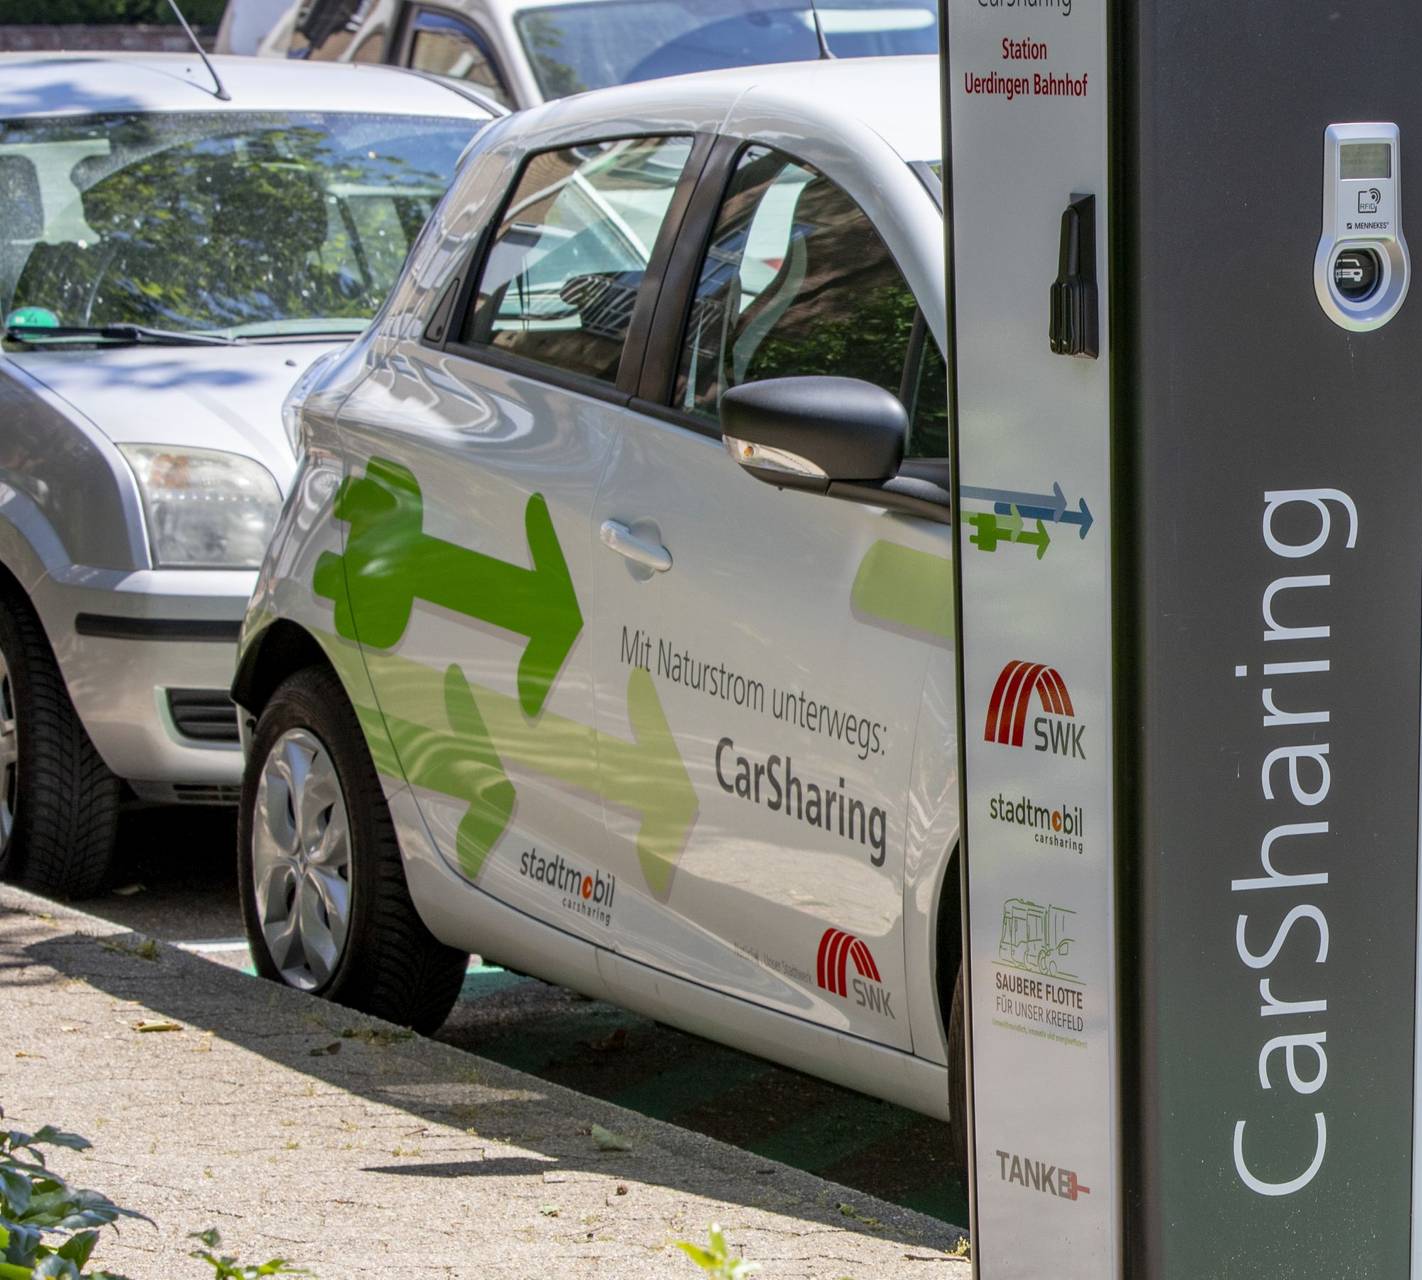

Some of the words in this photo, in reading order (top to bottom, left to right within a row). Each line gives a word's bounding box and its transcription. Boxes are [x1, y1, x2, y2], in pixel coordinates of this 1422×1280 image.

[1002, 37, 1047, 60] Station
[964, 71, 1029, 100] Uerdingen
[1033, 72, 1088, 96] Bahnhof
[1360, 202, 1375, 210] RFID
[621, 625, 652, 673] Mit
[657, 637, 765, 713] Naturstrom
[772, 687, 887, 760] unterwegs:
[1033, 716, 1086, 760] SWK
[715, 736, 887, 868] CarSharing
[989, 793, 1084, 837] stadtmobil
[1034, 831, 1084, 855] carsharing
[1232, 487, 1358, 1196] CarSharing
[519, 847, 615, 908] stadtmobil
[561, 897, 612, 927] carsharing
[852, 978, 896, 1020] SWK
[995, 972, 1043, 999] SAUBERE
[1045, 983, 1083, 1010] FLOTTE
[995, 994, 1013, 1013] FÜR
[1014, 999, 1044, 1024] UNSER
[1045, 1007, 1084, 1032] KREFELD
